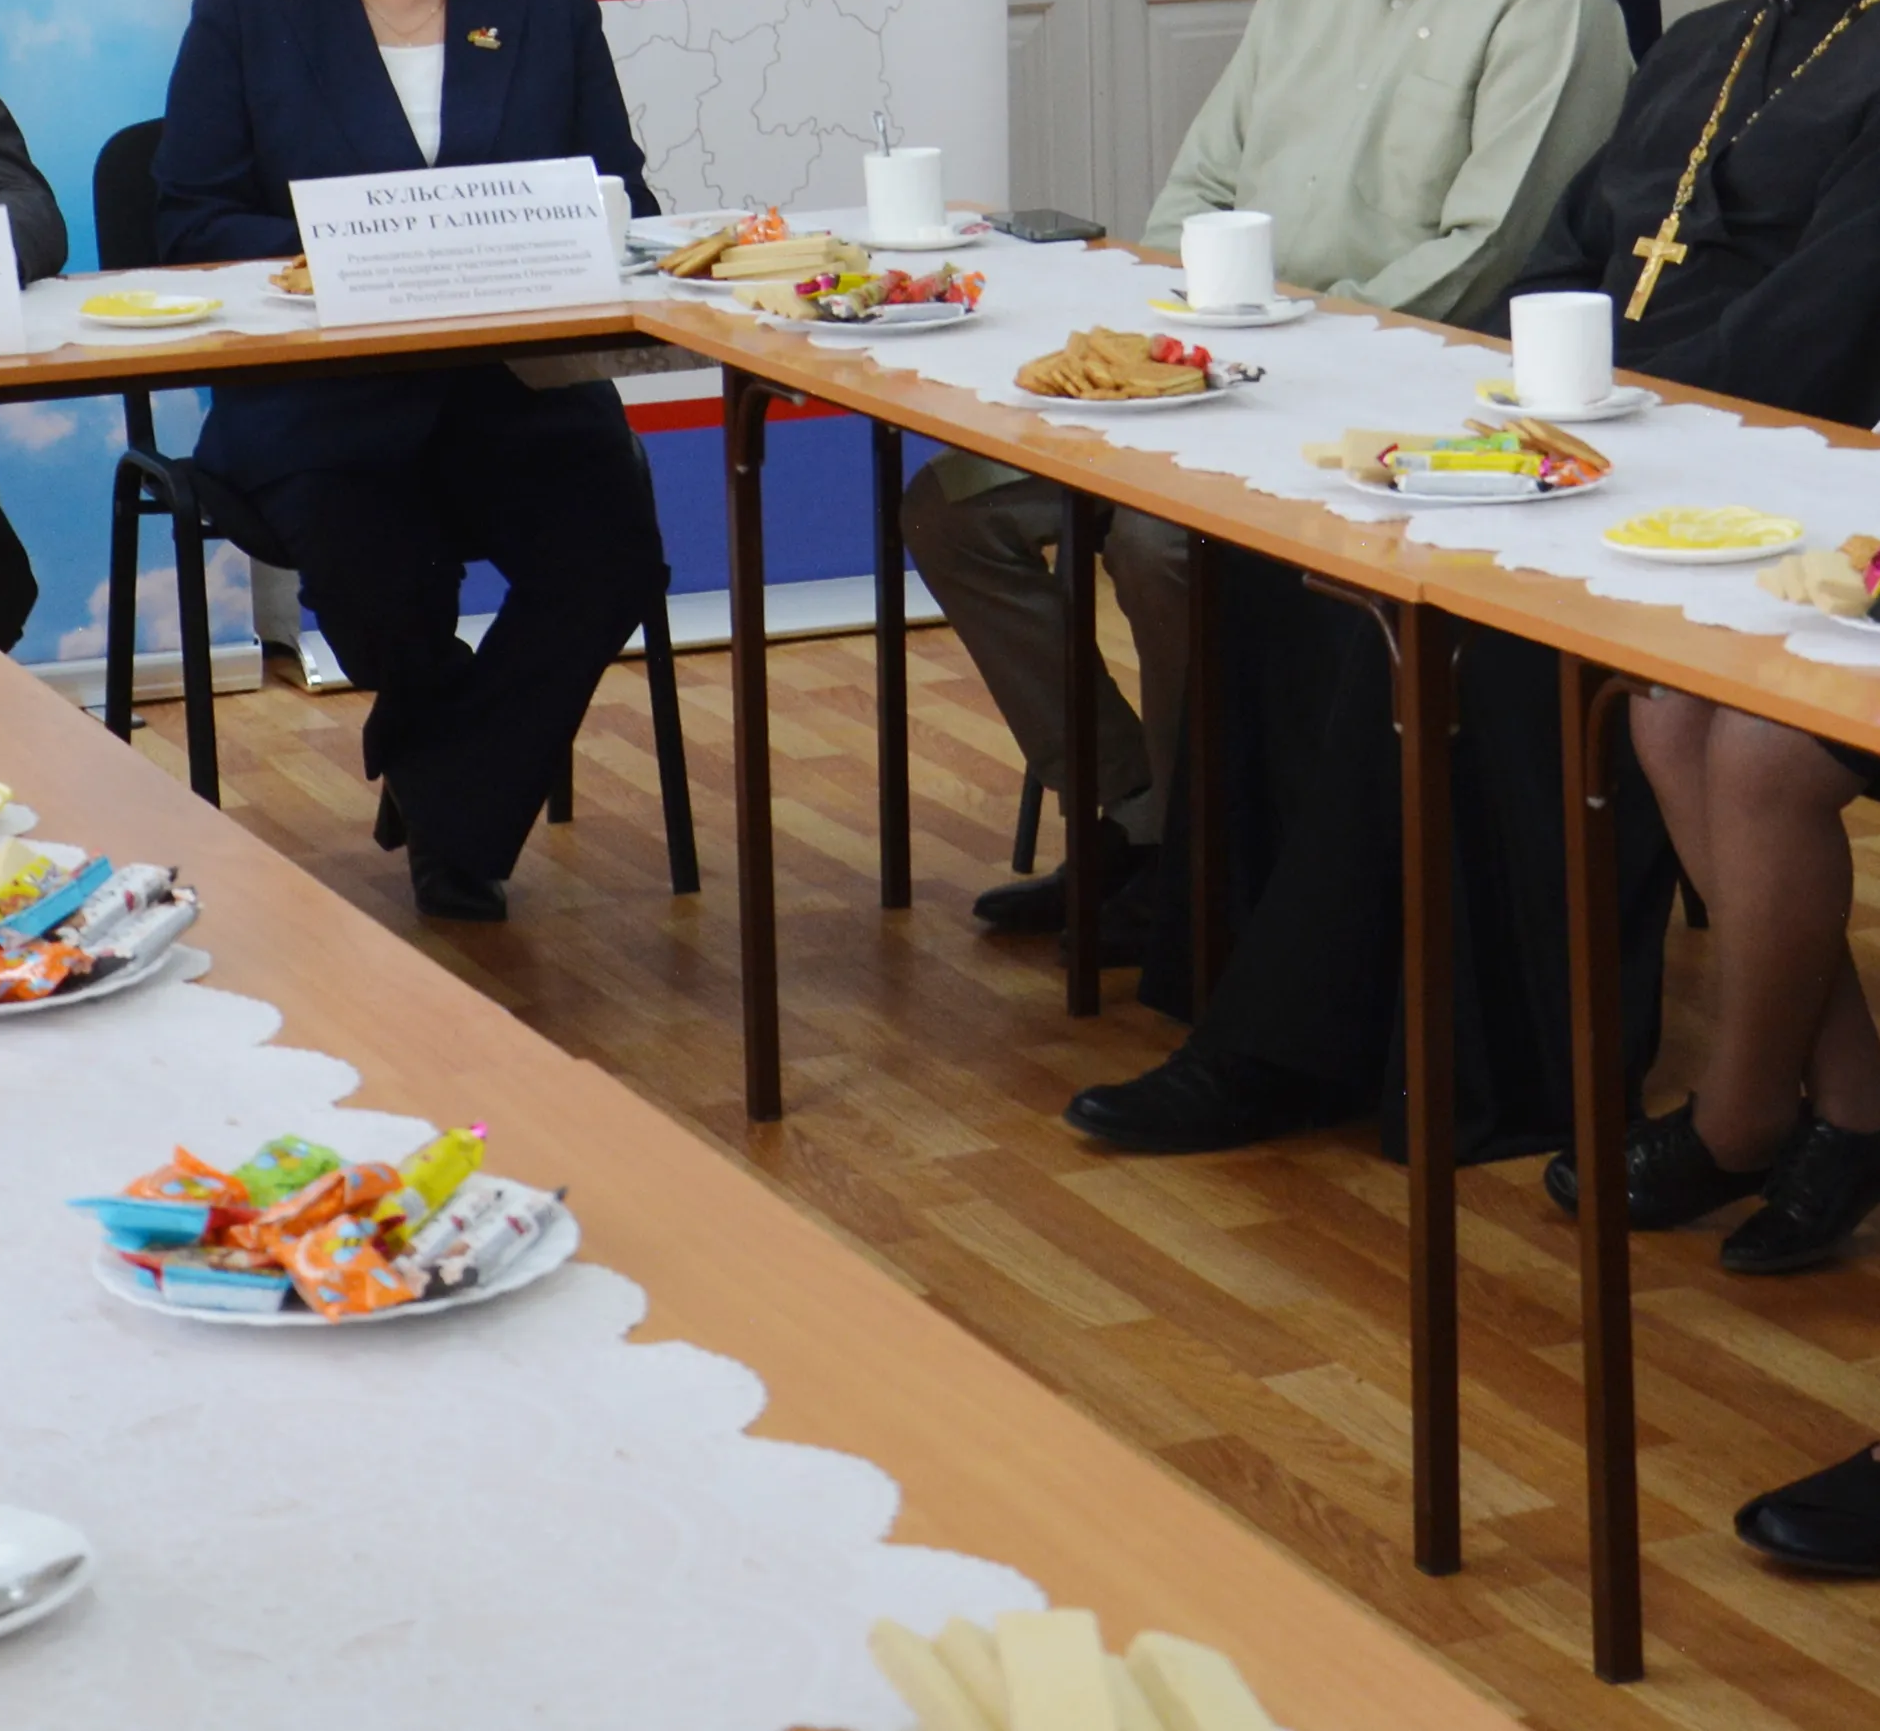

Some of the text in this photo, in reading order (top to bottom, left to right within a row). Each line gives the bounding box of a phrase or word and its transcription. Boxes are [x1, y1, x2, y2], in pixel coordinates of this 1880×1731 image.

[366, 178, 533, 207] КУЛЬСАРИНА
[310, 203, 598, 240] ГУЛЬНУР ГАЛИНУРОВНА
